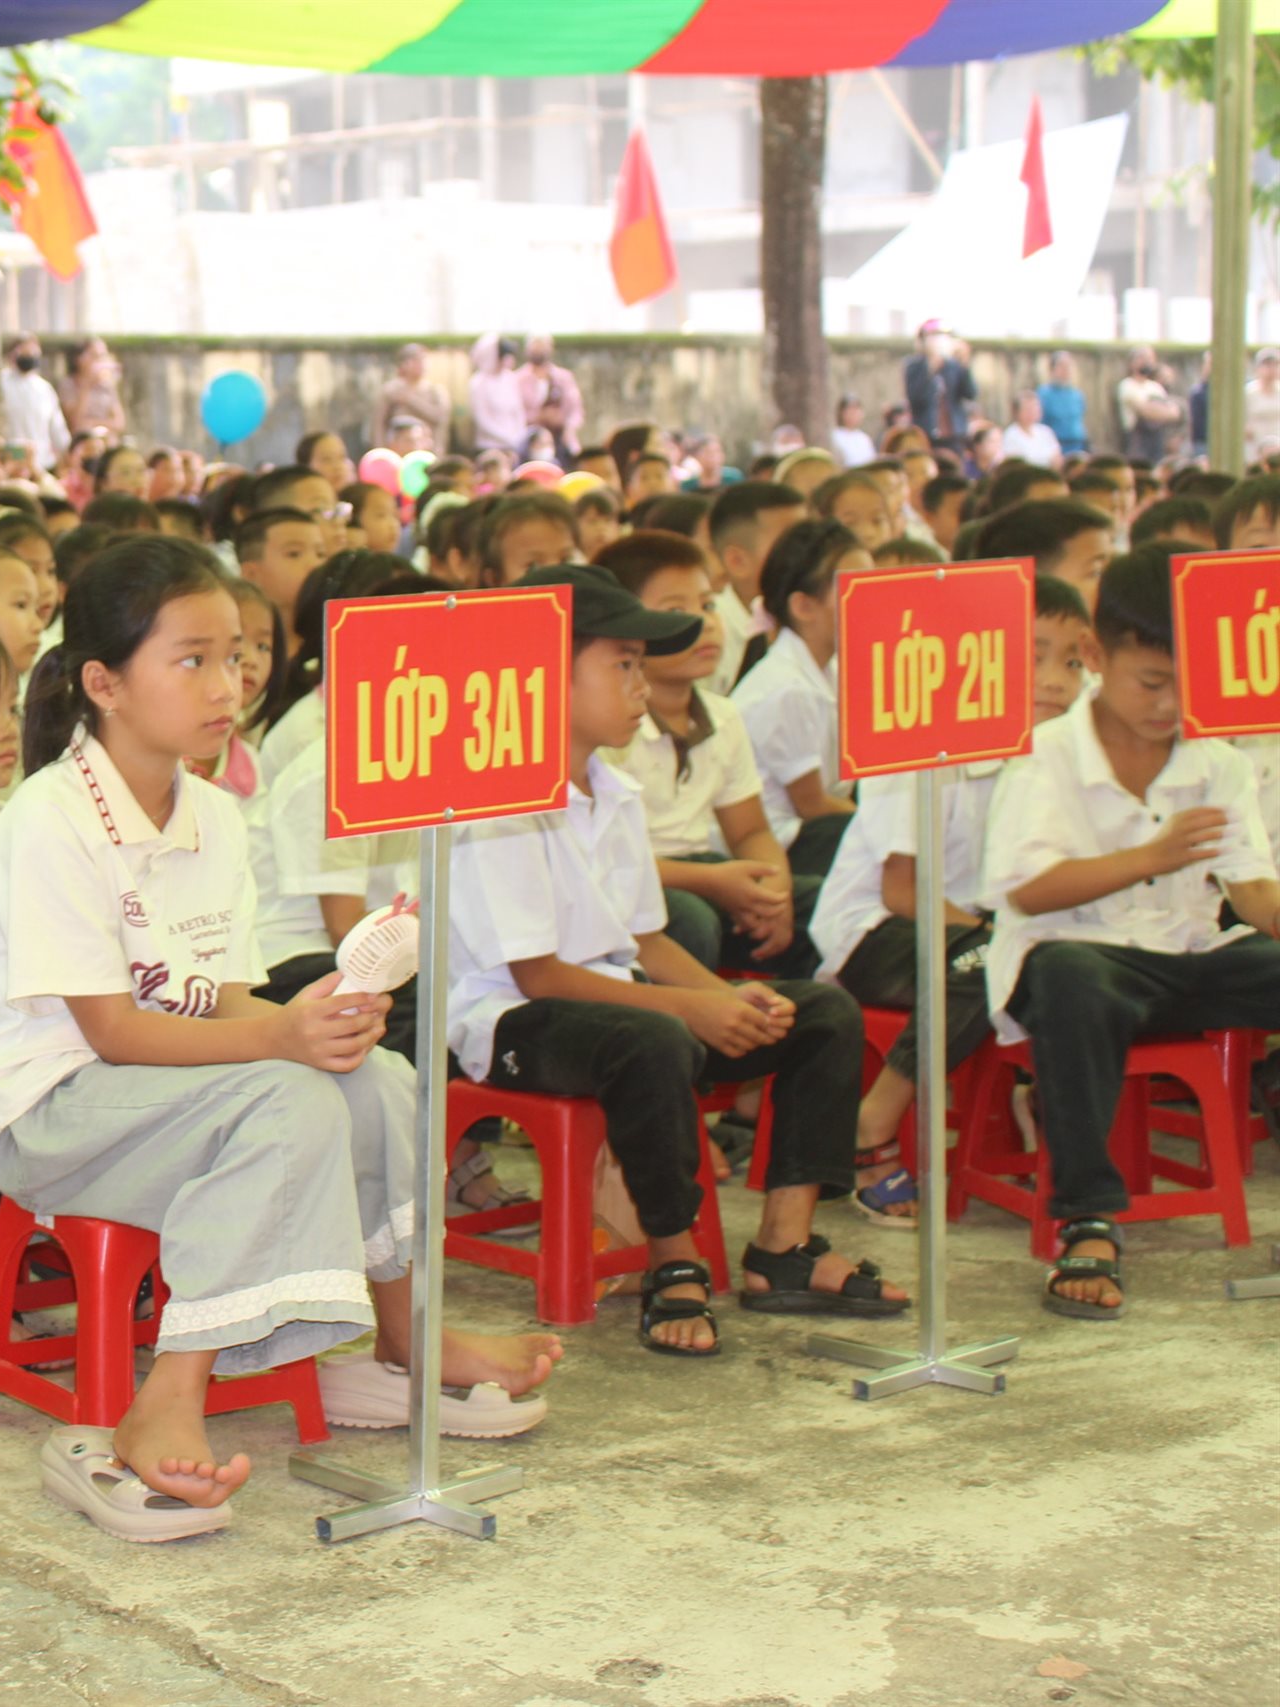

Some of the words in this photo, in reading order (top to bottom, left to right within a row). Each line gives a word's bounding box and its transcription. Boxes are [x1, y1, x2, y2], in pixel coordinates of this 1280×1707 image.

[357, 645, 449, 784] LỚP
[463, 666, 545, 773] 3A1
[872, 609, 945, 733] LỚP
[956, 629, 1006, 722] 2H
[177, 913, 217, 933] RETRO
